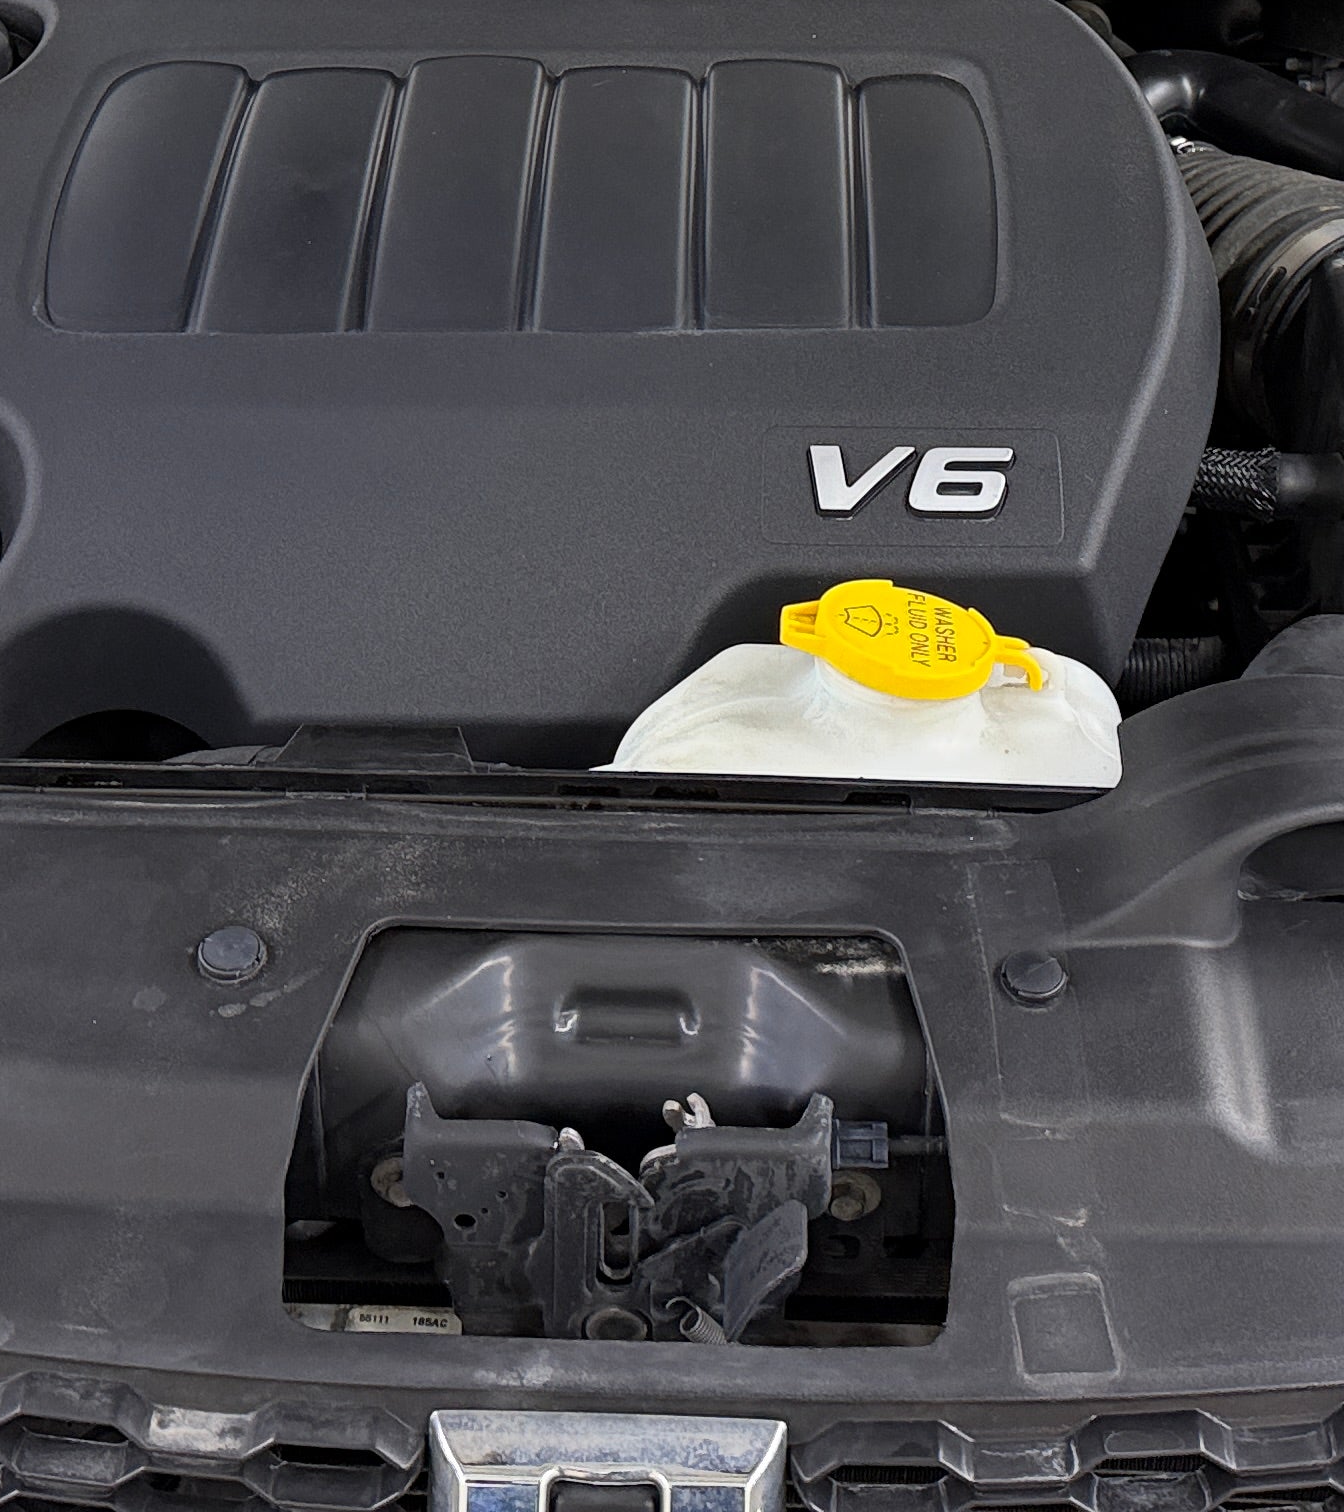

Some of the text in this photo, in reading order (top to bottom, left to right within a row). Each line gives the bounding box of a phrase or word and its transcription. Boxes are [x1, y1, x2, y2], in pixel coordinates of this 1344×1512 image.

[808, 444, 1016, 517] V6
[907, 592, 932, 668] FLUID ONLY
[932, 606, 958, 663] WASHER
